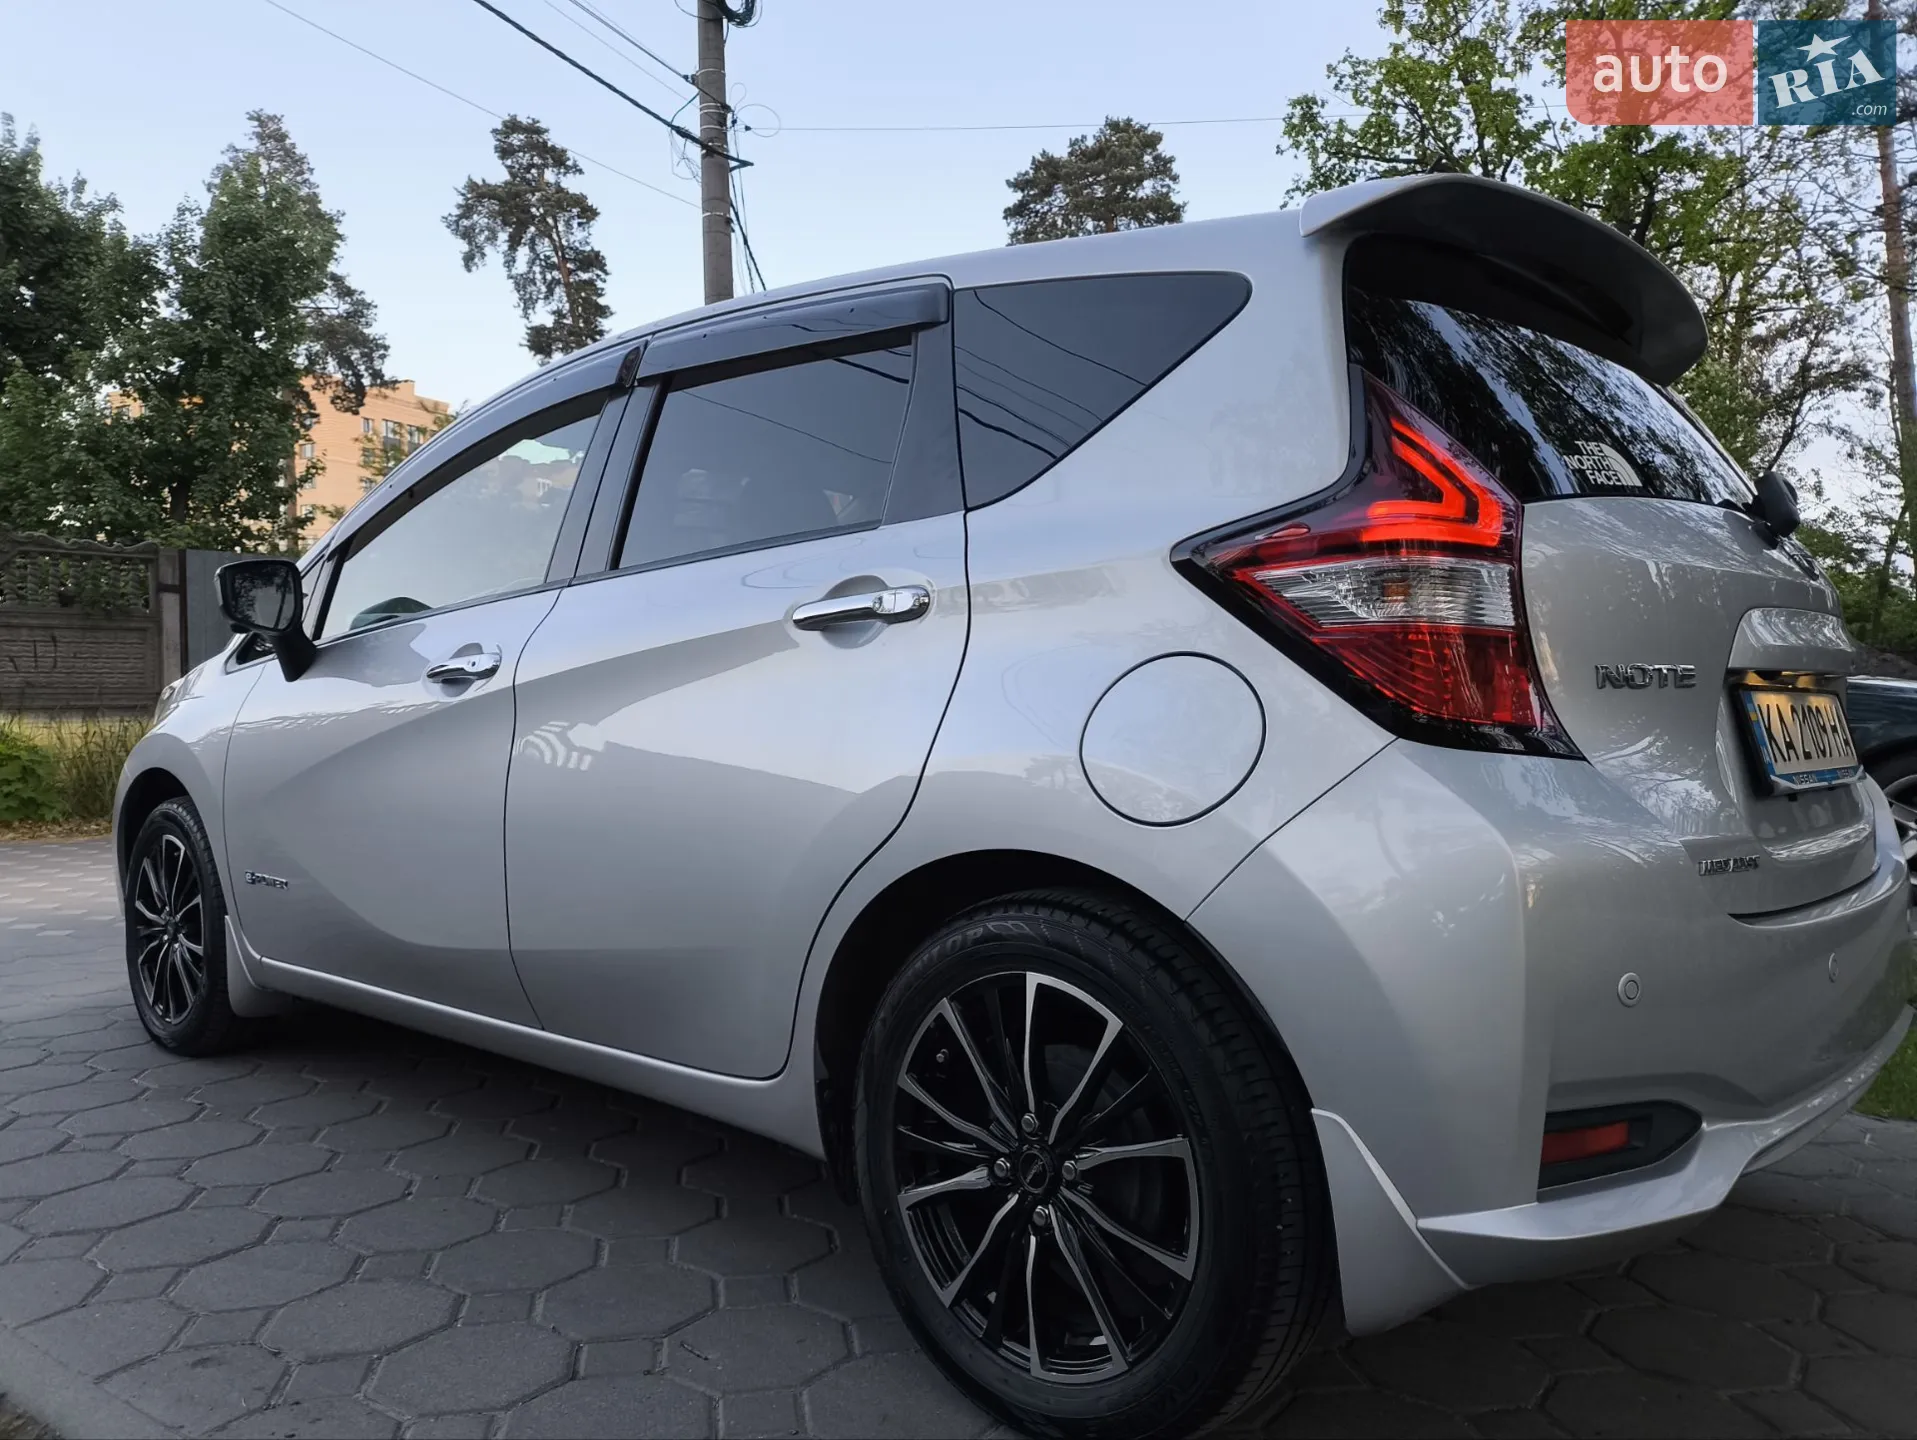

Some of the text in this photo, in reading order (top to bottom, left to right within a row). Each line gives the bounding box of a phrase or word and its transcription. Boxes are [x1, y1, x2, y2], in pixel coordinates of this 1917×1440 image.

[1574, 440, 1605, 456] THE
[1563, 454, 1615, 471] NORTH
[1585, 469, 1623, 486] FACE
[1594, 662, 1697, 690] NOTE
